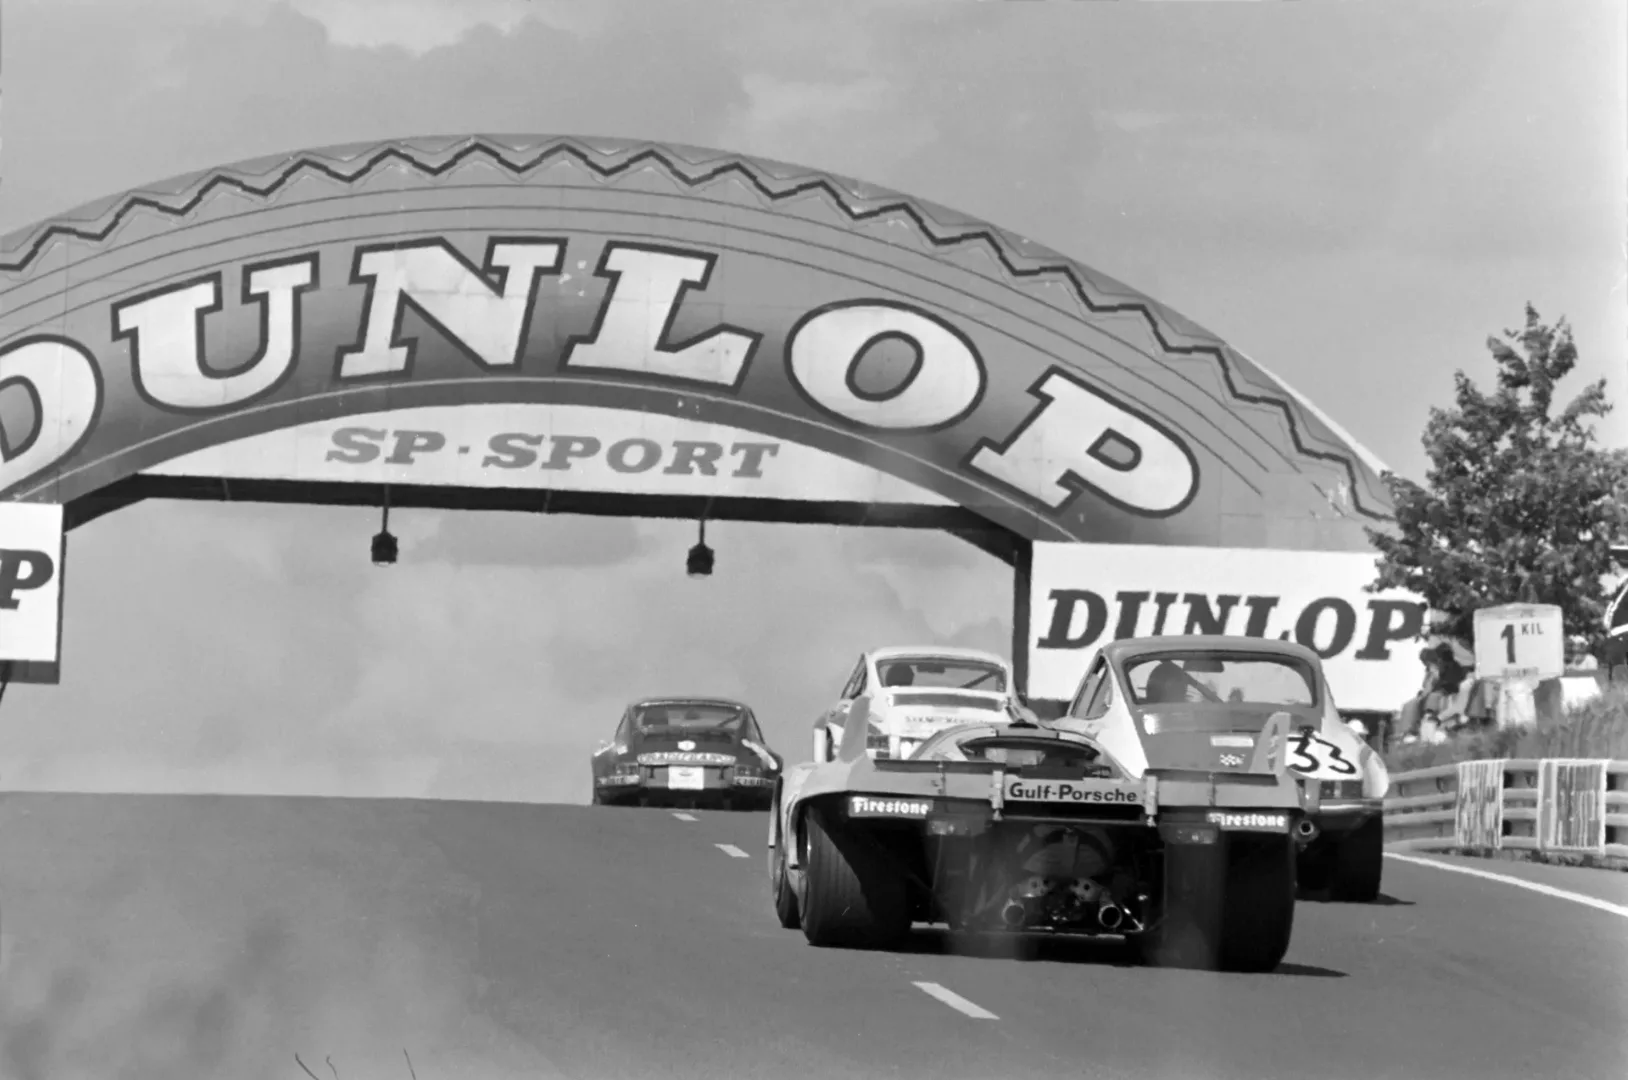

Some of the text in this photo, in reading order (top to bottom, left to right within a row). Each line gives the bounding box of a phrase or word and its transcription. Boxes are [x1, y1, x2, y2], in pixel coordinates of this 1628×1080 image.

[1036, 588, 1427, 661] DUNLOP
[1501, 622, 1545, 665] 1 KIL
[1286, 733, 1357, 775] 33
[851, 796, 930, 816] Firestone
[1008, 781, 1138, 803] Gulf-Porsche
